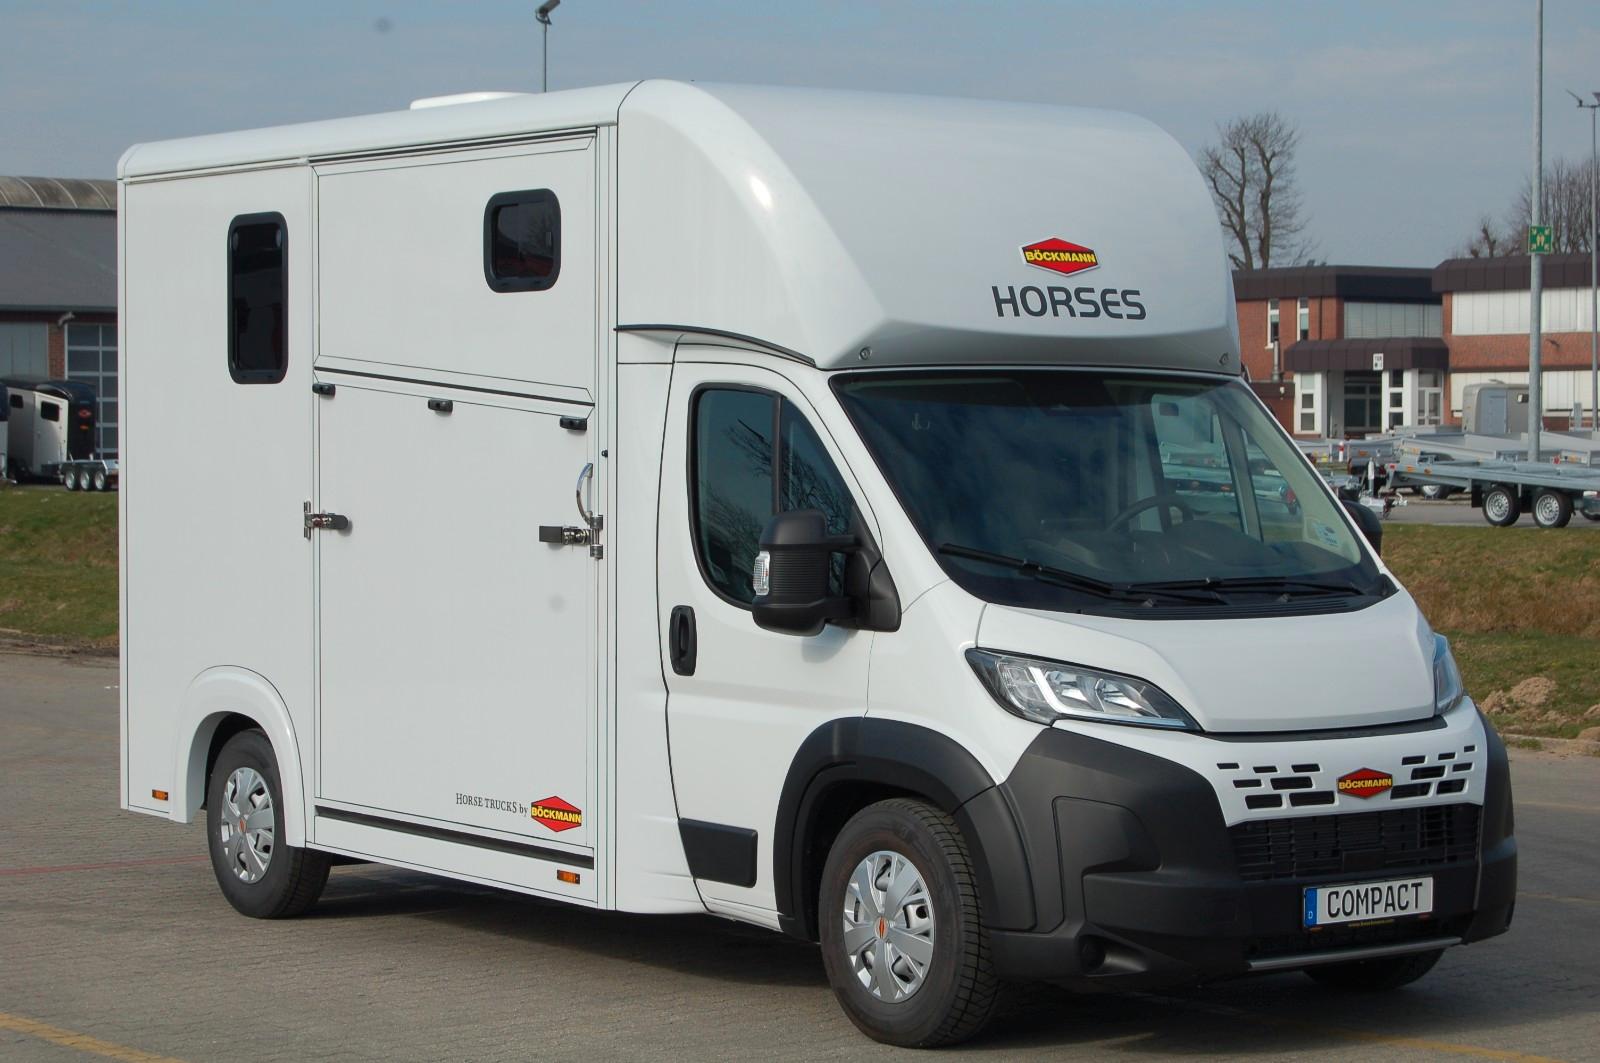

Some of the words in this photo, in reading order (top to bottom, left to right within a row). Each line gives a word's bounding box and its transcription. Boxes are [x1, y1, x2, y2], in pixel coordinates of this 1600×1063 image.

[1025, 249, 1097, 264] BÖCKMANN
[991, 285, 1146, 320] HORSES
[1338, 778, 1392, 790] BÖCKMANN
[455, 793, 483, 808] HORSE
[484, 797, 517, 814] TRUCKS
[519, 803, 529, 817] by
[531, 806, 582, 824] BÖCKMANN
[1308, 911, 1314, 919] D
[1327, 881, 1423, 918] COMPACT
